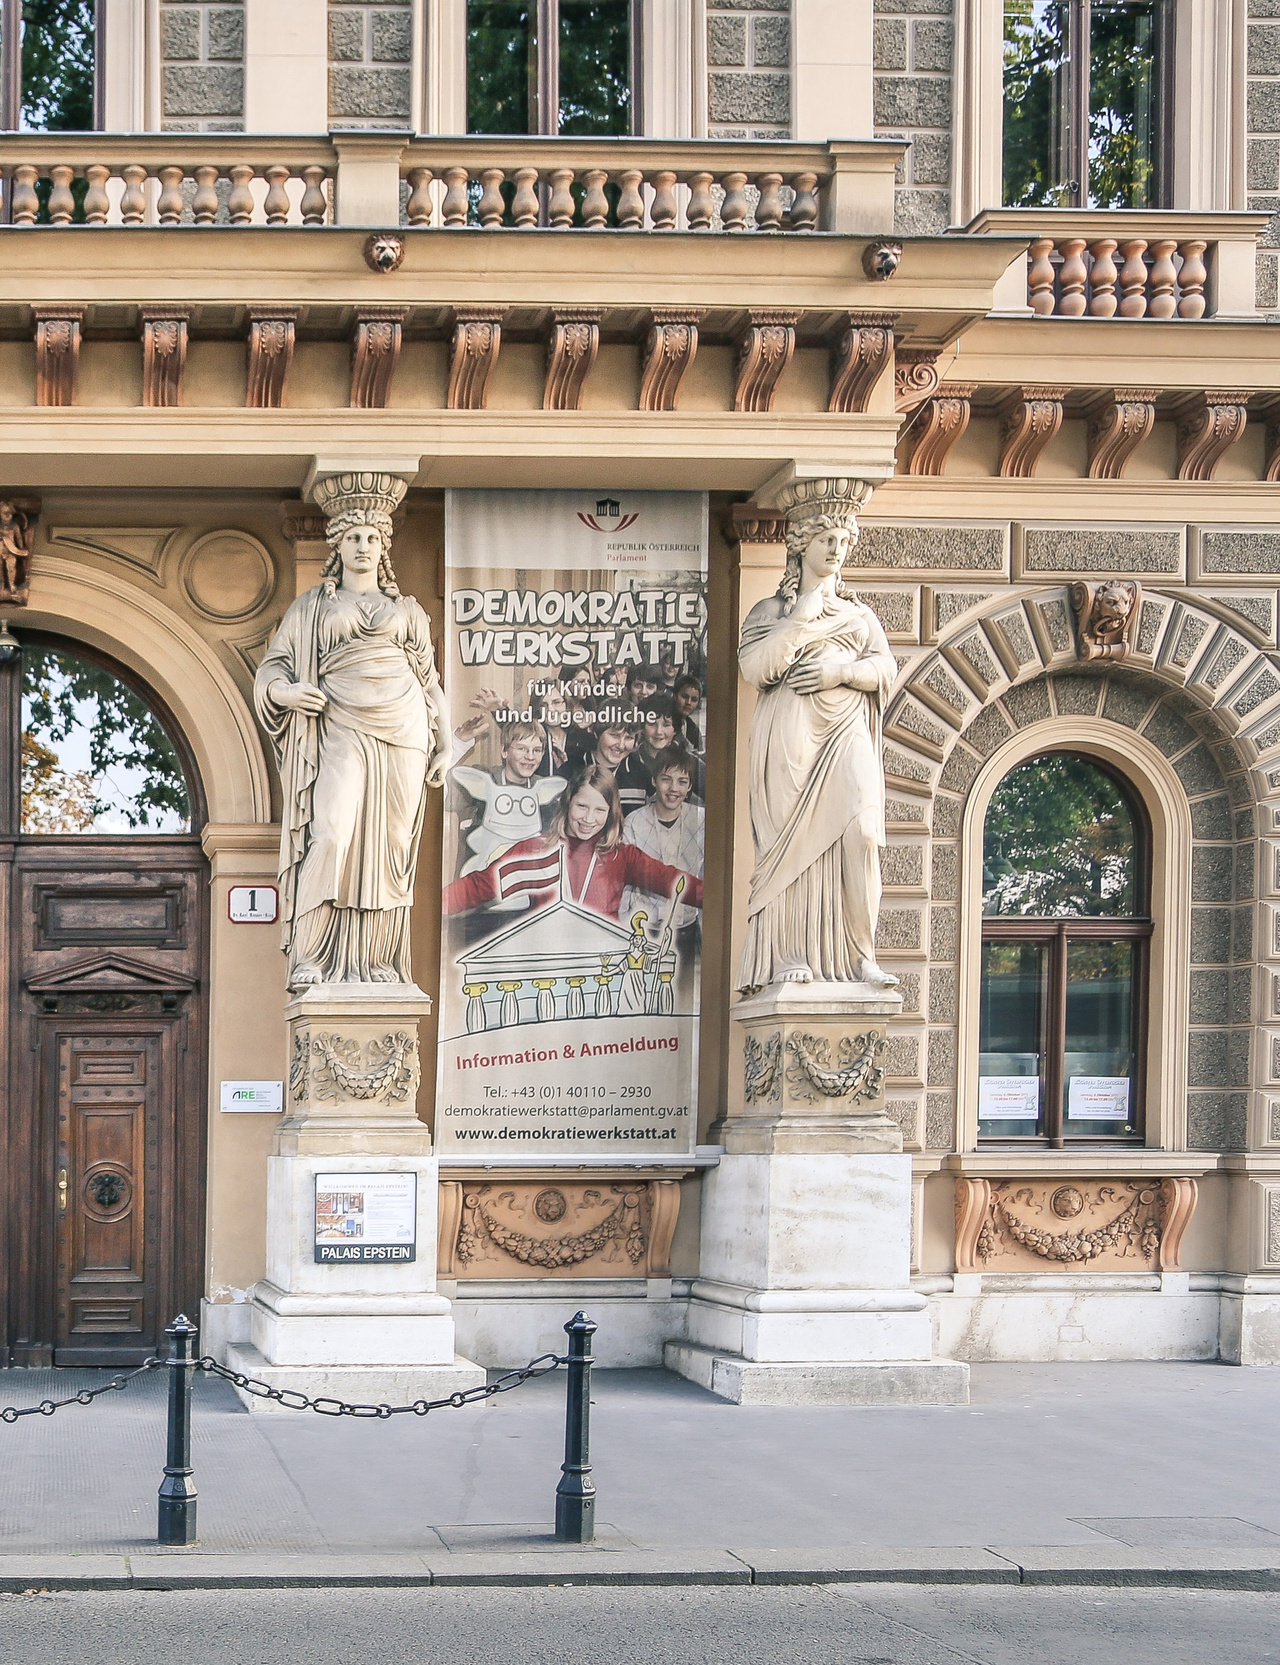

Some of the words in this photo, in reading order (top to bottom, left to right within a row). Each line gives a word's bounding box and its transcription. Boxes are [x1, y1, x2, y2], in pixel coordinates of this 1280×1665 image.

[607, 543, 647, 551] REPUBLIK
[649, 541, 700, 552] ÖSTERREICH
[607, 554, 647, 562] Parlament
[459, 628, 693, 666] WERKSTATT
[526, 678, 554, 697] für
[560, 679, 626, 697] Kinder
[495, 705, 532, 723] und
[537, 706, 657, 728] Jugendliche
[248, 890, 258, 911] 1
[456, 1047, 558, 1070] Information
[563, 1044, 575, 1059] &
[580, 1035, 679, 1058] Anmeldung
[483, 1085, 508, 1098] Tel.:
[511, 1086, 535, 1098] +43
[539, 1085, 561, 1100] (0)1
[566, 1086, 606, 1098] 40110
[620, 1086, 652, 1098] 2930
[444, 1104, 688, 1119] demokratiewerkstatt@parlament.gv.at
[455, 1126, 677, 1140] www.demokratiewerkstatt.at
[321, 1247, 360, 1259] PALAIS
[364, 1247, 410, 1258] EPSTEIN
